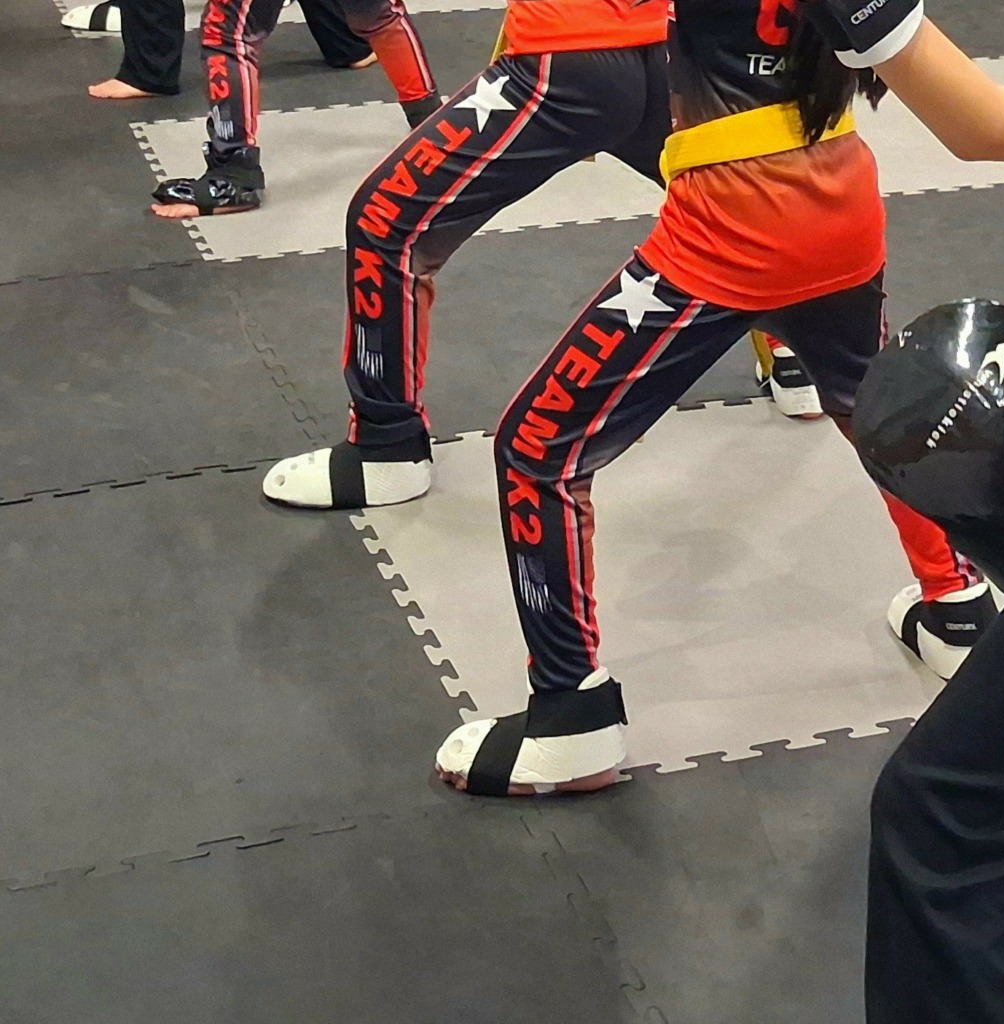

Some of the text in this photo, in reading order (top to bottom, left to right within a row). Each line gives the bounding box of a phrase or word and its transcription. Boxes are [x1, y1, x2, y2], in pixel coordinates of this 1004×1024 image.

[207, 54, 231, 101] K2
[746, 53, 786, 76] TEA
[353, 119, 473, 320] TEAM K2
[506, 322, 625, 546] TEAM K2
